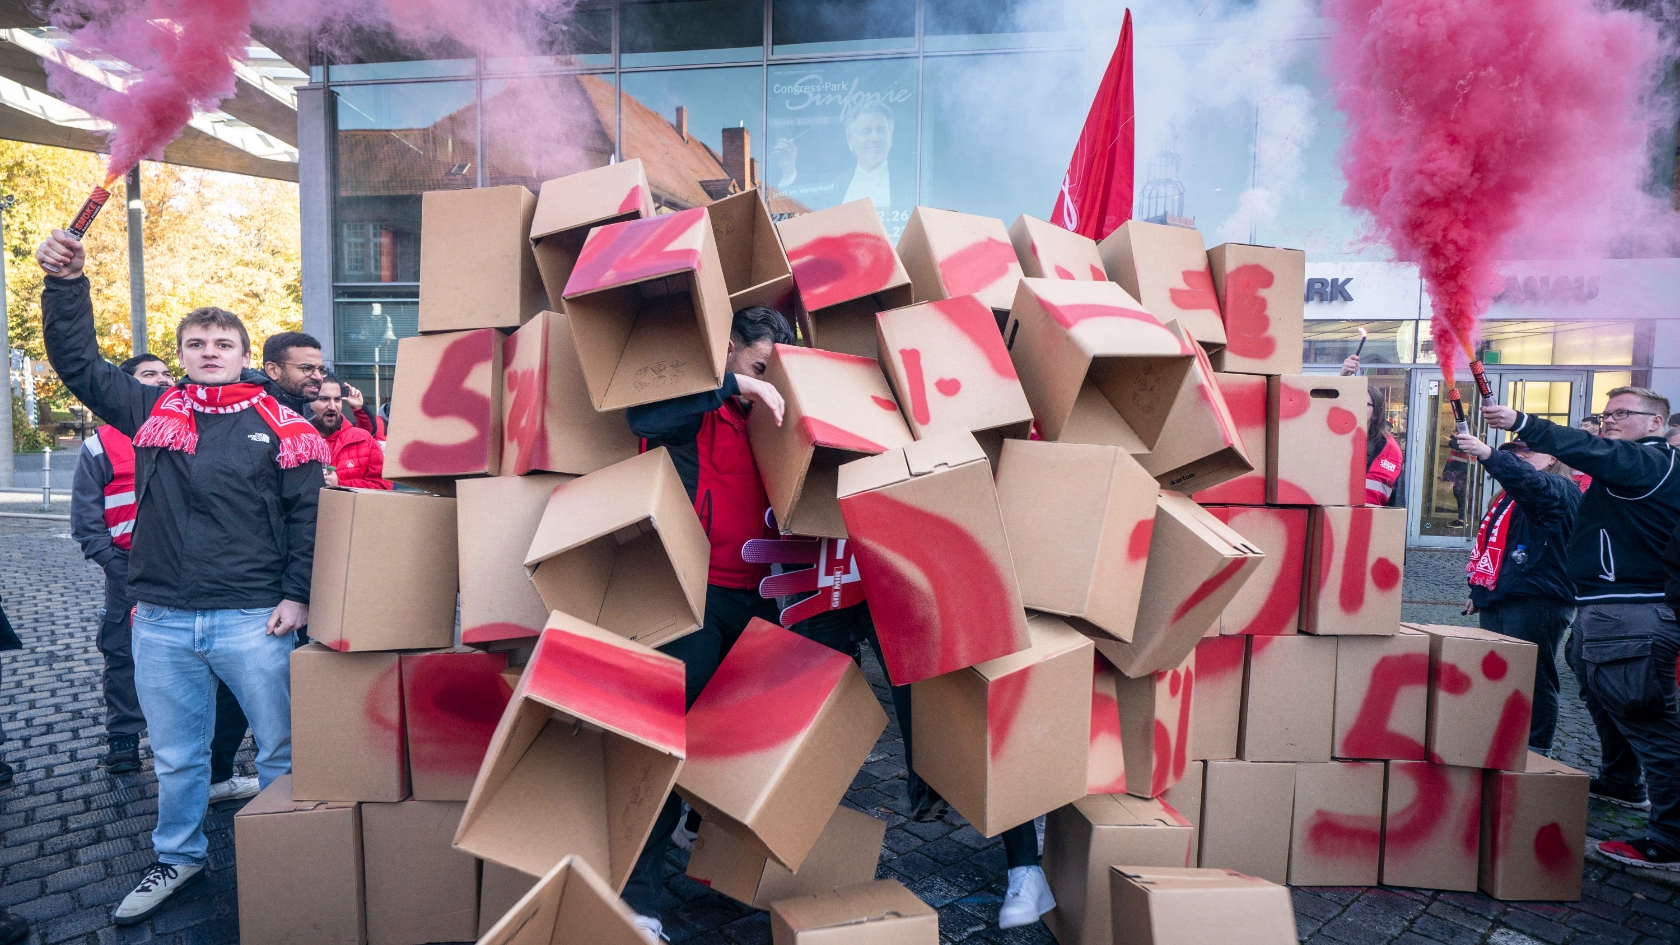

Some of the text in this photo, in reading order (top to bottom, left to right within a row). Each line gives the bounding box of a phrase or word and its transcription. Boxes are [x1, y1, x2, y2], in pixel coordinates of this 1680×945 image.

[785, 74, 912, 122] Sinfonie
[798, 183, 834, 194] Vorverkauf
[75, 201, 97, 231] SMOKE
[1492, 275, 1600, 303] ANAU
[832, 570, 841, 608] GIB MIR
